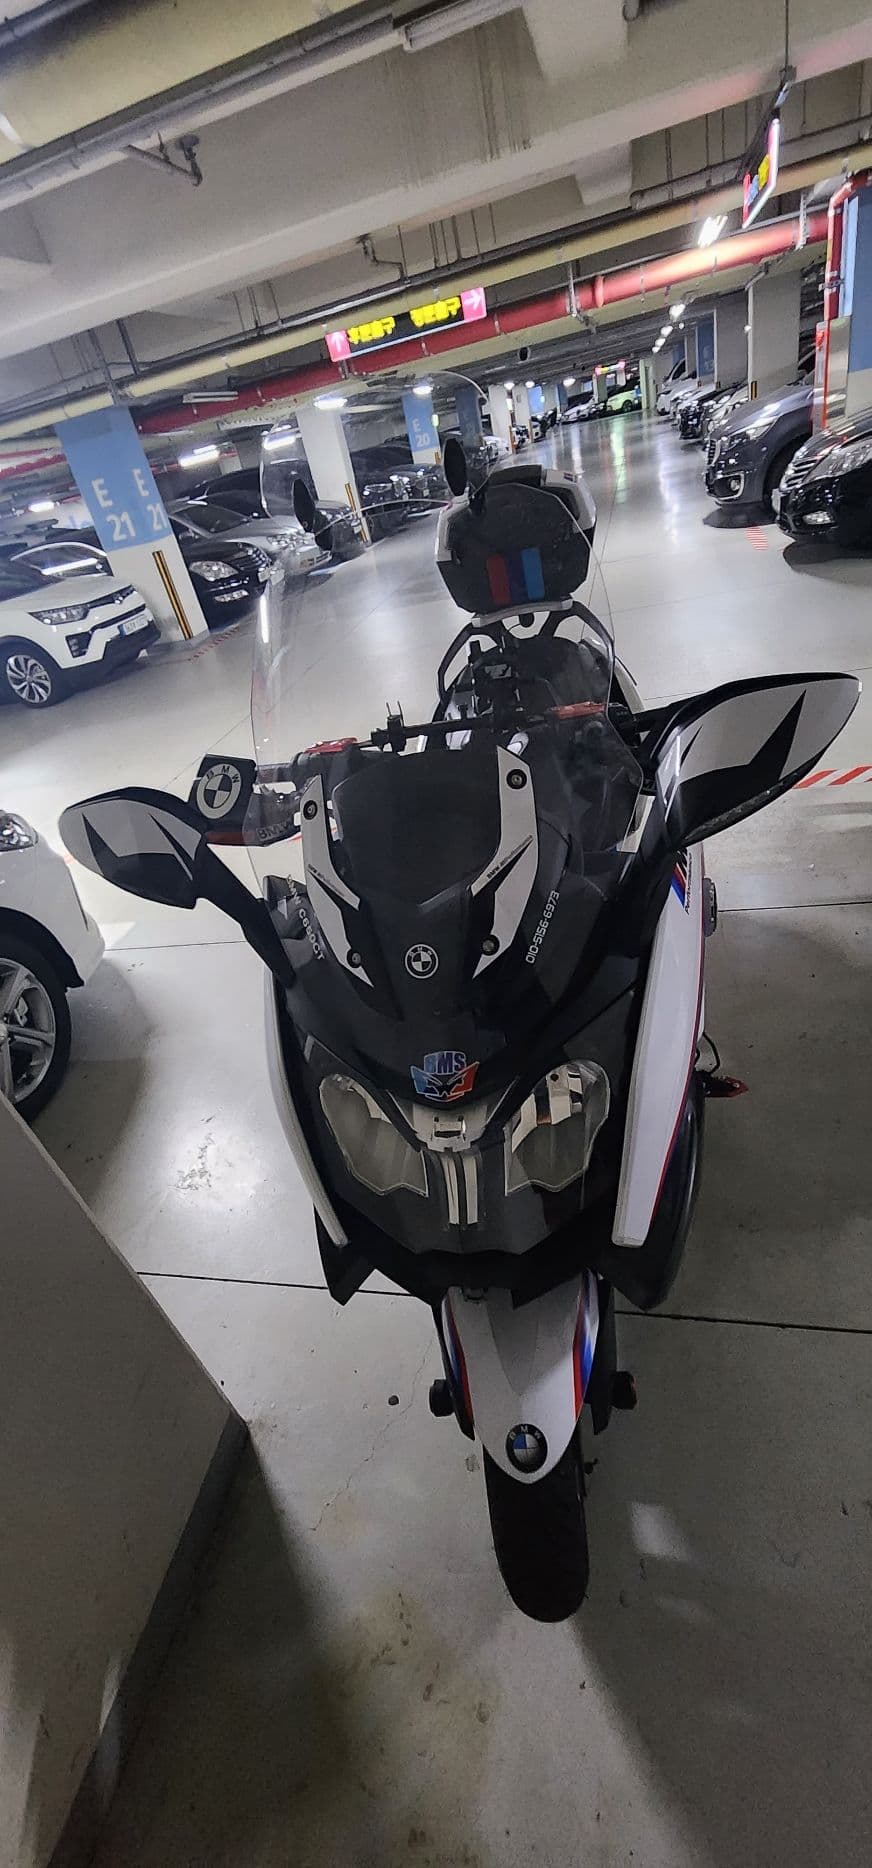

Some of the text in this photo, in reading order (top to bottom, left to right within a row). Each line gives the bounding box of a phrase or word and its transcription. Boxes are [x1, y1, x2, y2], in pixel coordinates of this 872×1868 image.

[412, 418, 421, 433] E
[415, 432, 431, 448] 20
[92, 478, 113, 508] E
[132, 467, 149, 497] E
[106, 511, 136, 541] 21
[146, 503, 168, 531] 21
[206, 765, 240, 784] BMW
[299, 907, 325, 961] C650CT
[525, 890, 561, 965] 010-5156-6973
[424, 1051, 466, 1075] BMS
[509, 1425, 542, 1440] BMW
